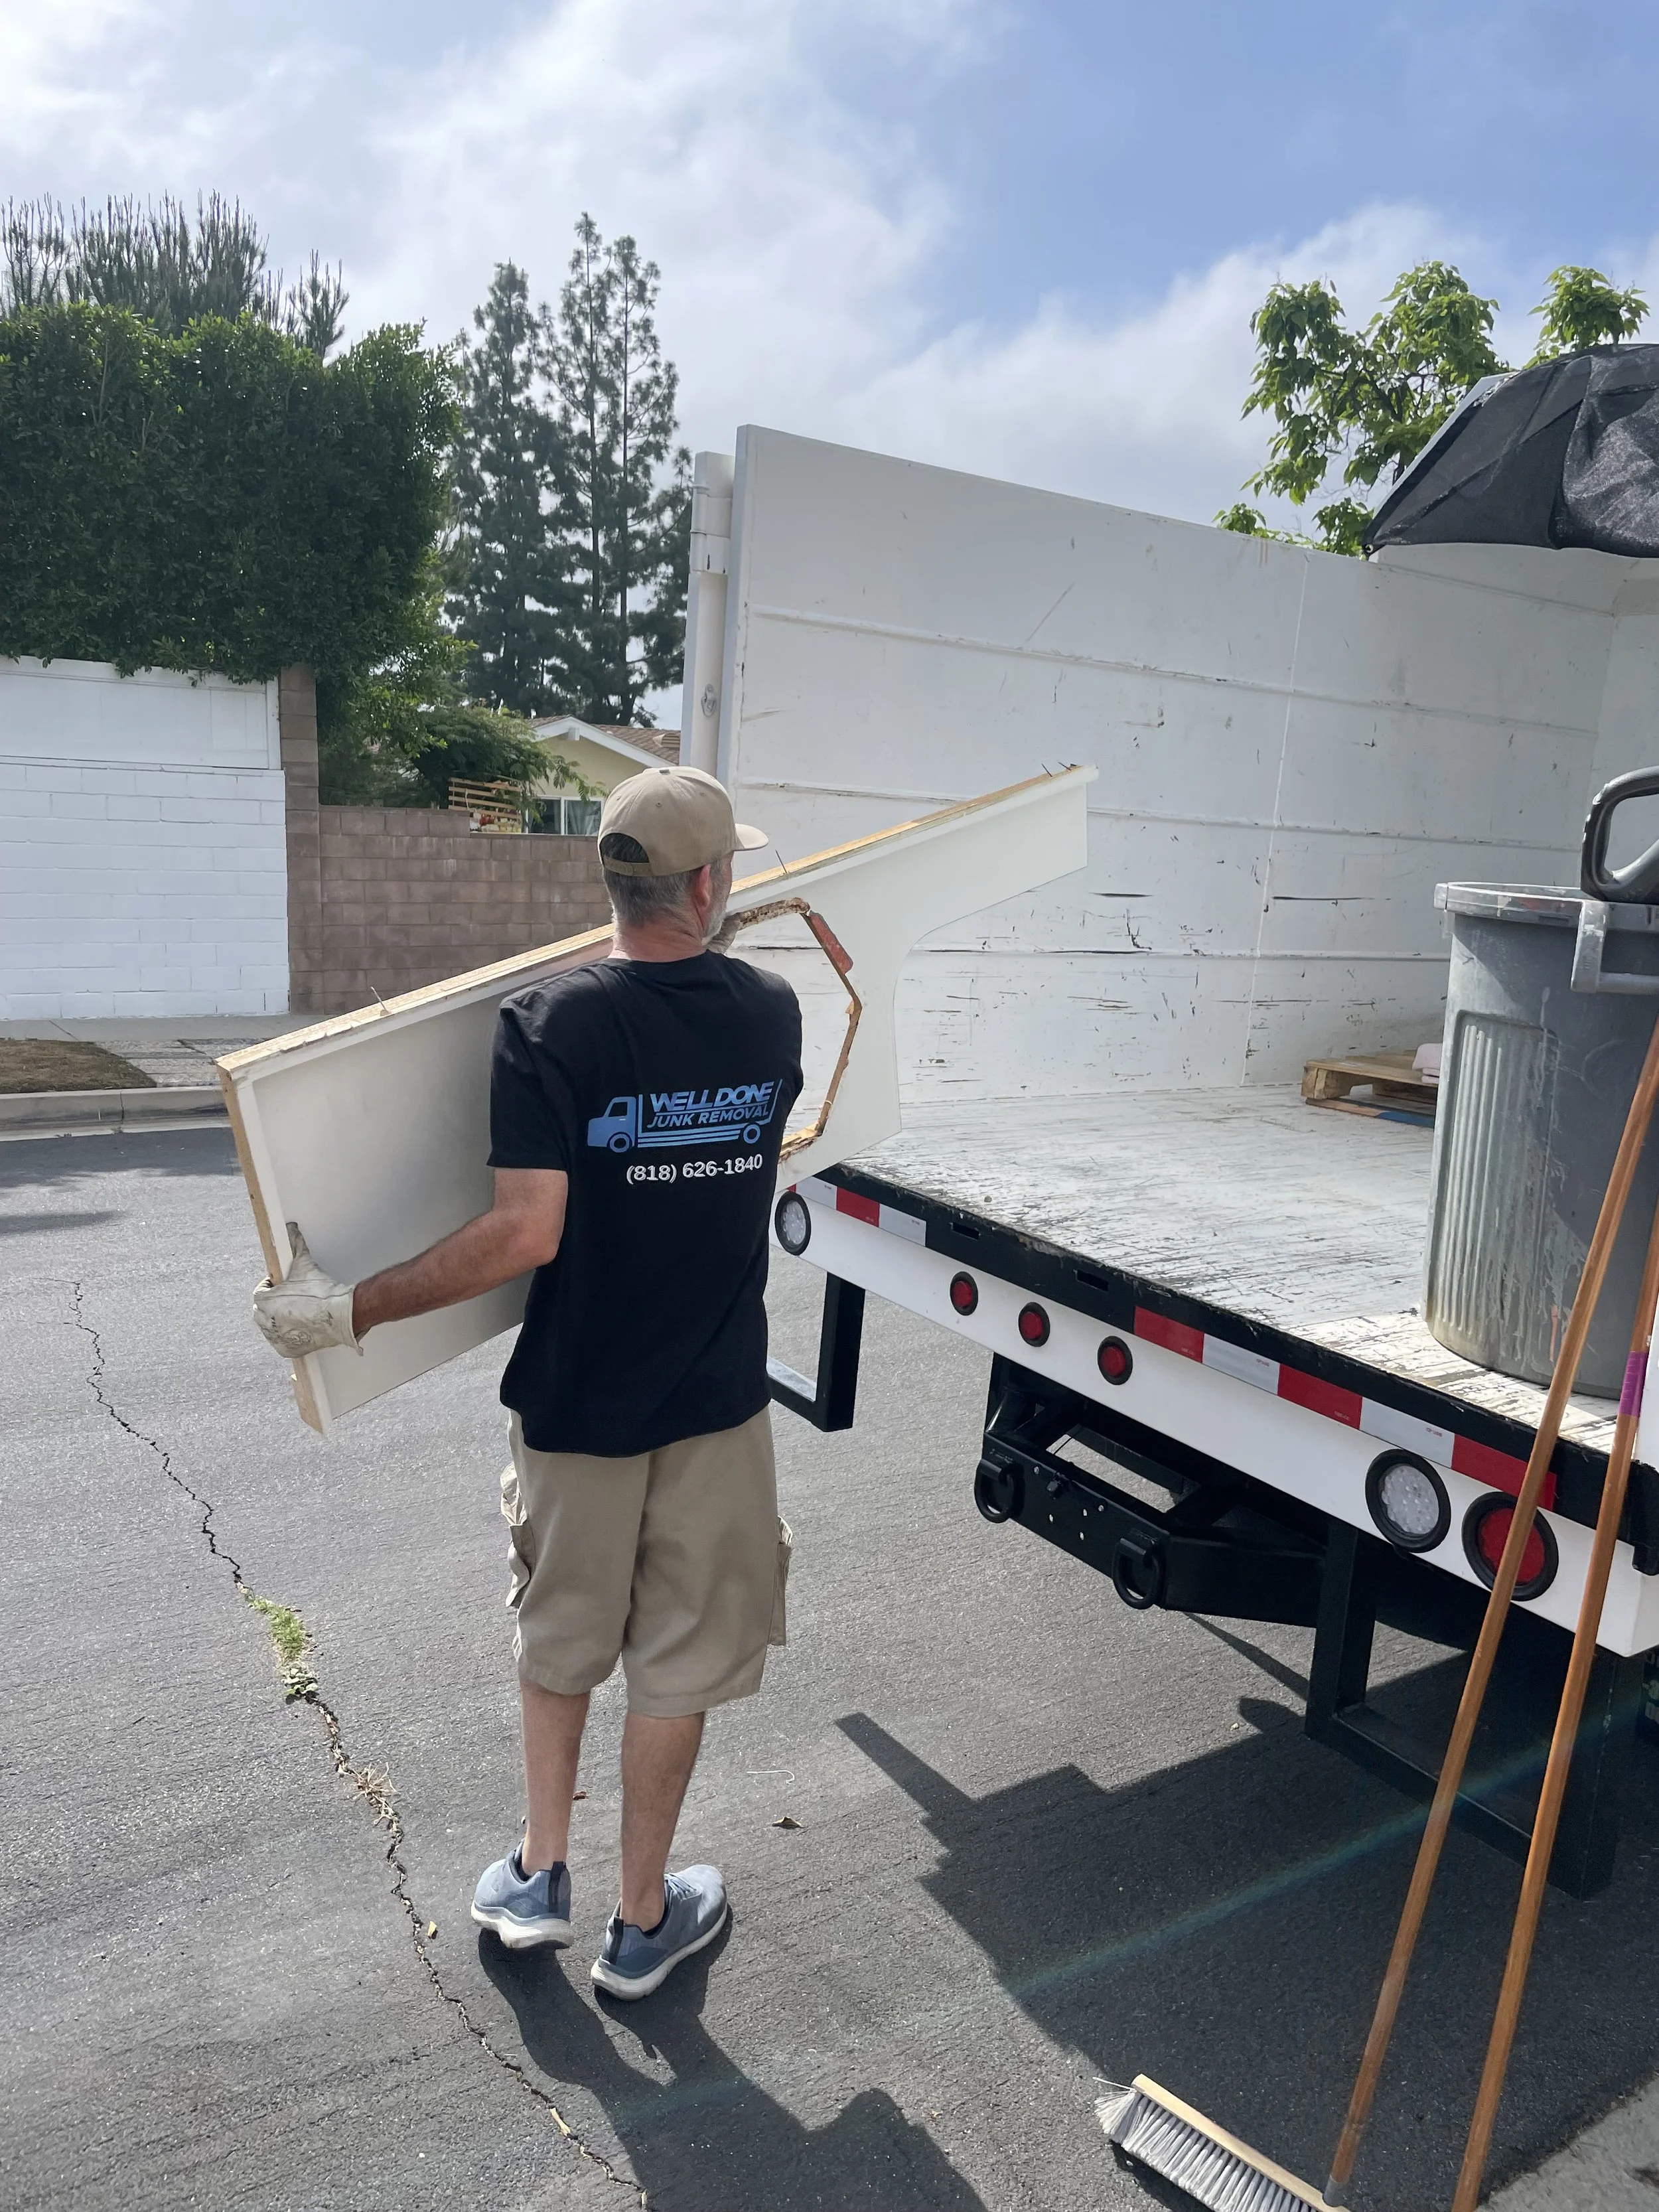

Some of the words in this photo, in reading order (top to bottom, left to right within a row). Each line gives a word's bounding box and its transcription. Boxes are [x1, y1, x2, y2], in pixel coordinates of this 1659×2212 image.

[647, 1113, 695, 1128] JUNK
[697, 1104, 768, 1124] REMOVAL
[626, 1164, 677, 1185] (818)
[683, 1153, 763, 1178] 626-1840
